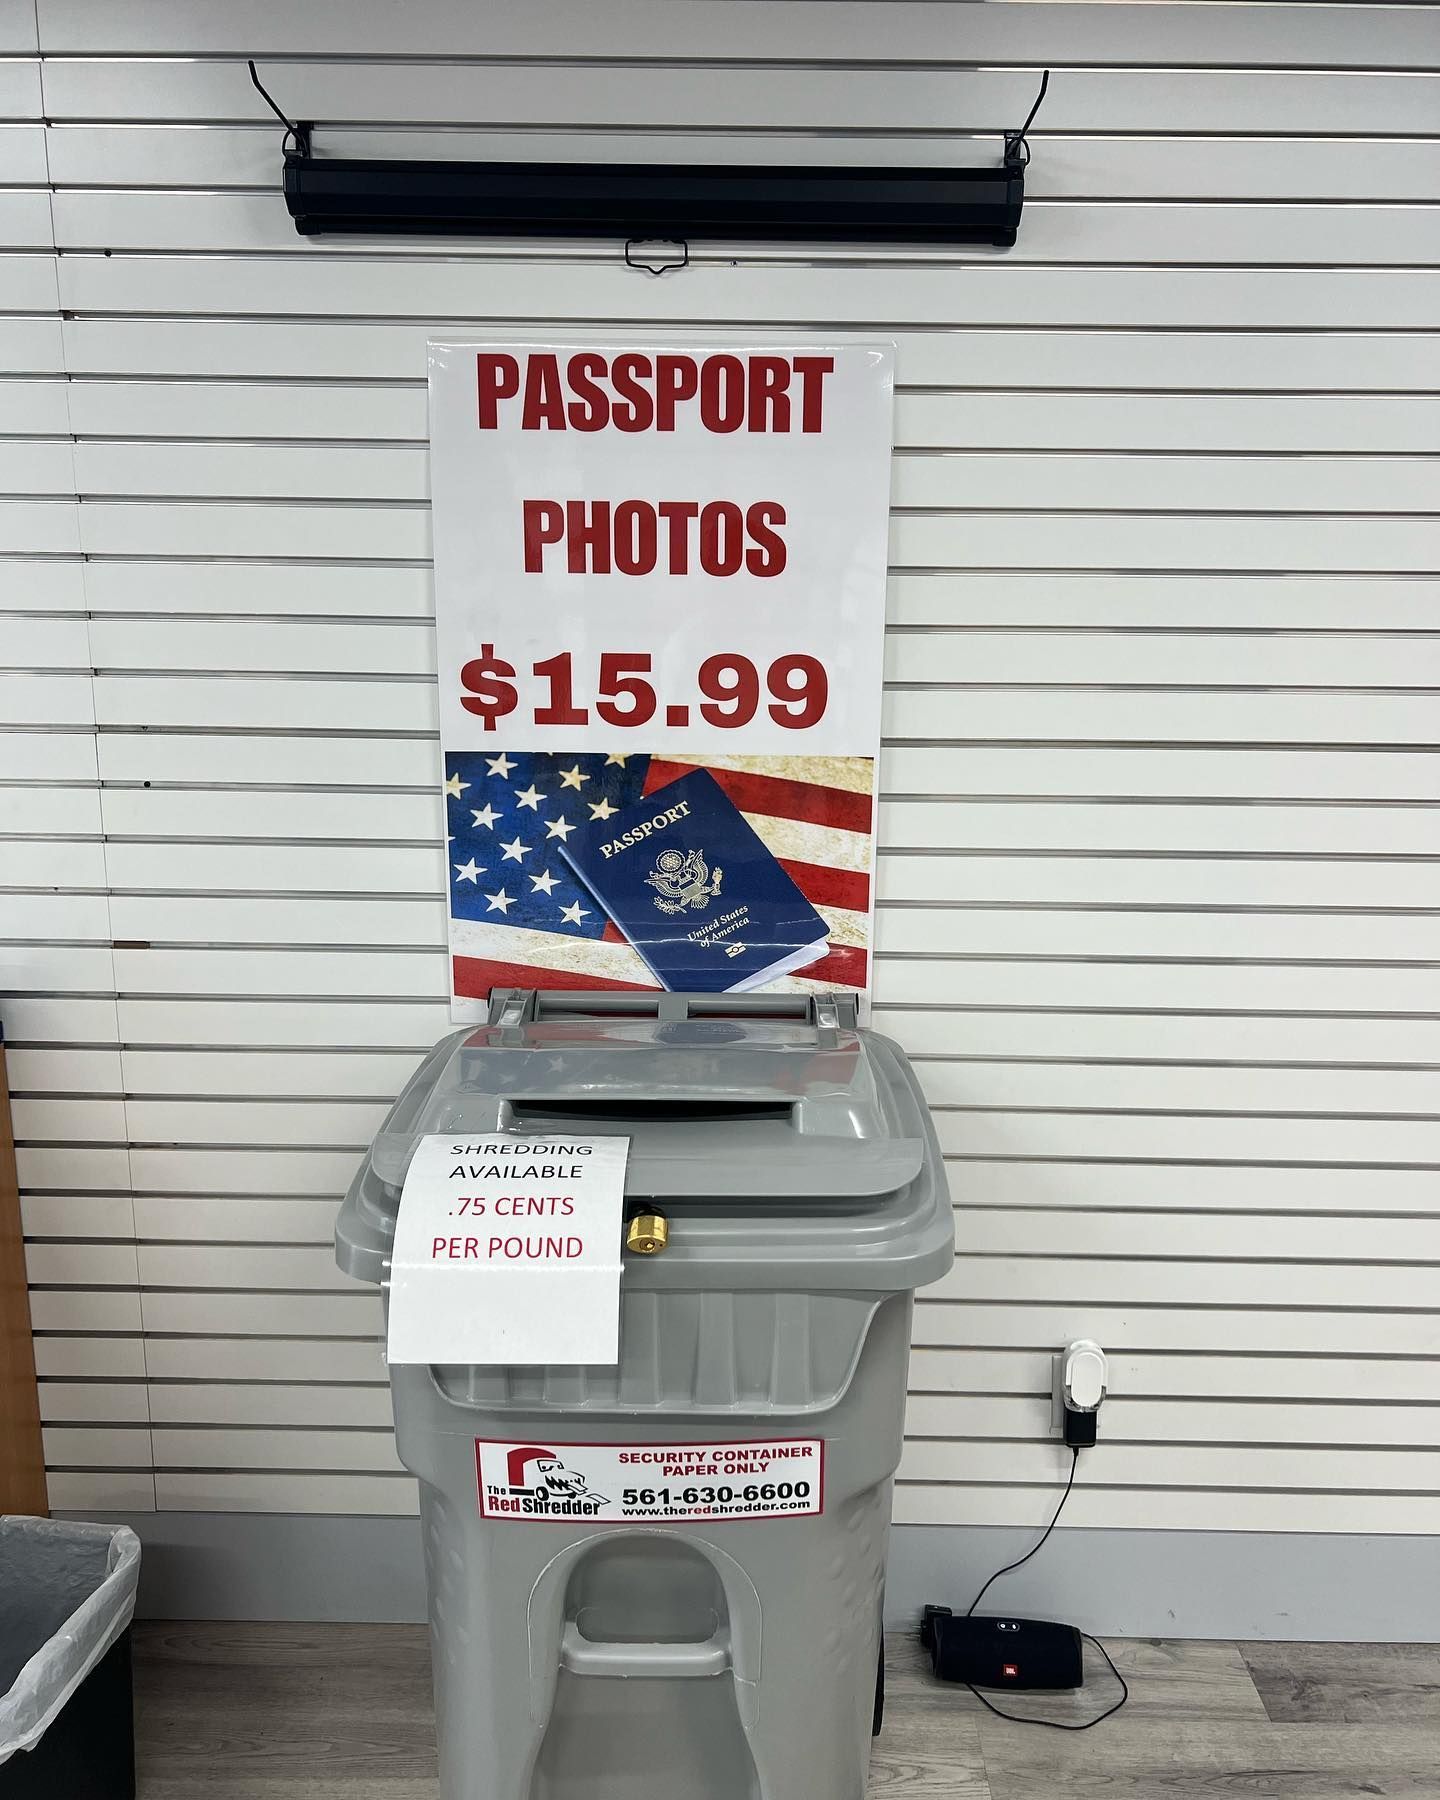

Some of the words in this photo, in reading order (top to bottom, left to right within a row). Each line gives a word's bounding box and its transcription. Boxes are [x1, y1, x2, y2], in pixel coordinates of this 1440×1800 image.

[477, 353, 834, 434] PASSPORT
[523, 500, 787, 577] PHOTOS
[459, 643, 829, 731] $15.99
[599, 800, 691, 859] PASSPORT
[687, 918, 720, 942] United
[720, 905, 749, 925] States
[700, 935, 710, 948] of
[712, 917, 750, 942] America
[450, 1144, 593, 1156] SHREDDING
[449, 1165, 584, 1179] AVAILABLE
[448, 1197, 486, 1216] .75
[494, 1197, 575, 1216] CENTS
[432, 1237, 479, 1259] PER
[488, 1237, 584, 1259] POUND
[618, 1451, 707, 1464] SECURITY
[712, 1446, 813, 1462] CONTAINER
[662, 1464, 719, 1477] PAPER
[724, 1462, 770, 1474] ONLY
[487, 1485, 506, 1495] The
[622, 1481, 811, 1506] 561-630-6600
[622, 1500, 811, 1516] www.theredshredder.com
